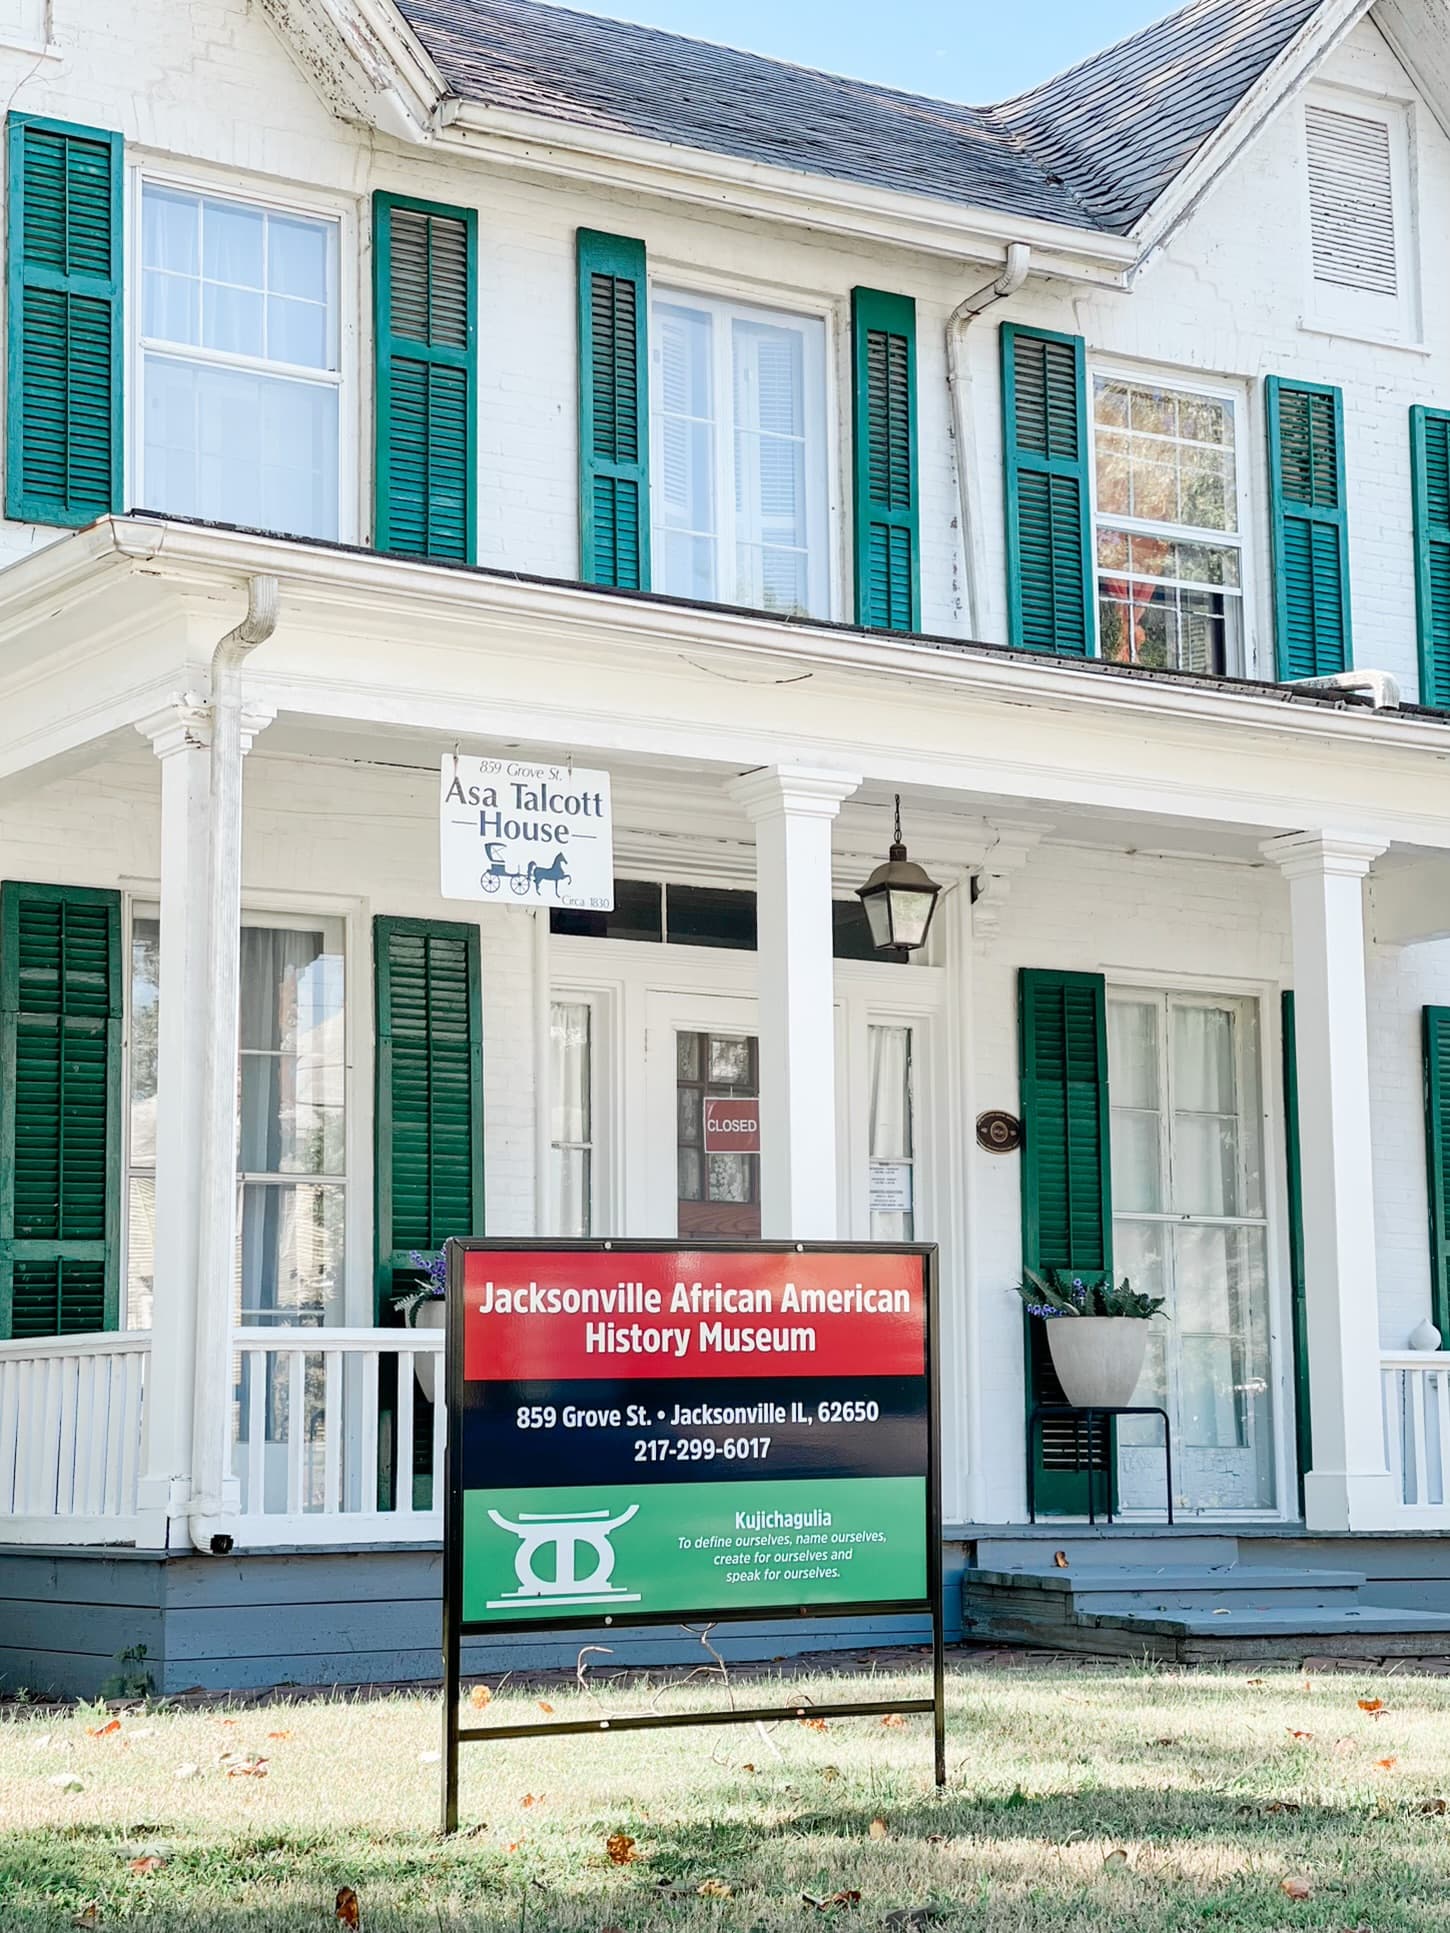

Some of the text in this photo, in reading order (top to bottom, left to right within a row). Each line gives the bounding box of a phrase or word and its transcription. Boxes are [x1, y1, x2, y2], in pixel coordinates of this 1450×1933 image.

[480, 760, 563, 781] 859 Grove St.
[445, 776, 603, 817] Asa Talcott
[479, 810, 569, 844] House
[562, 895, 609, 909] Circa 1830
[707, 1119, 757, 1132] CLOSED
[479, 1282, 910, 1314] Jacksonville African American
[586, 1322, 816, 1357] History Museum
[516, 1401, 879, 1429] 859 Grove St. Jacksonville IL, 62650
[634, 1438, 771, 1462] 217-299-6017
[735, 1509, 832, 1531] Kujichagulia
[678, 1531, 887, 1549] To define ourselves, name ourselves,
[713, 1548, 853, 1566] create for ourselves and
[726, 1566, 841, 1584] speak for ourselves.
